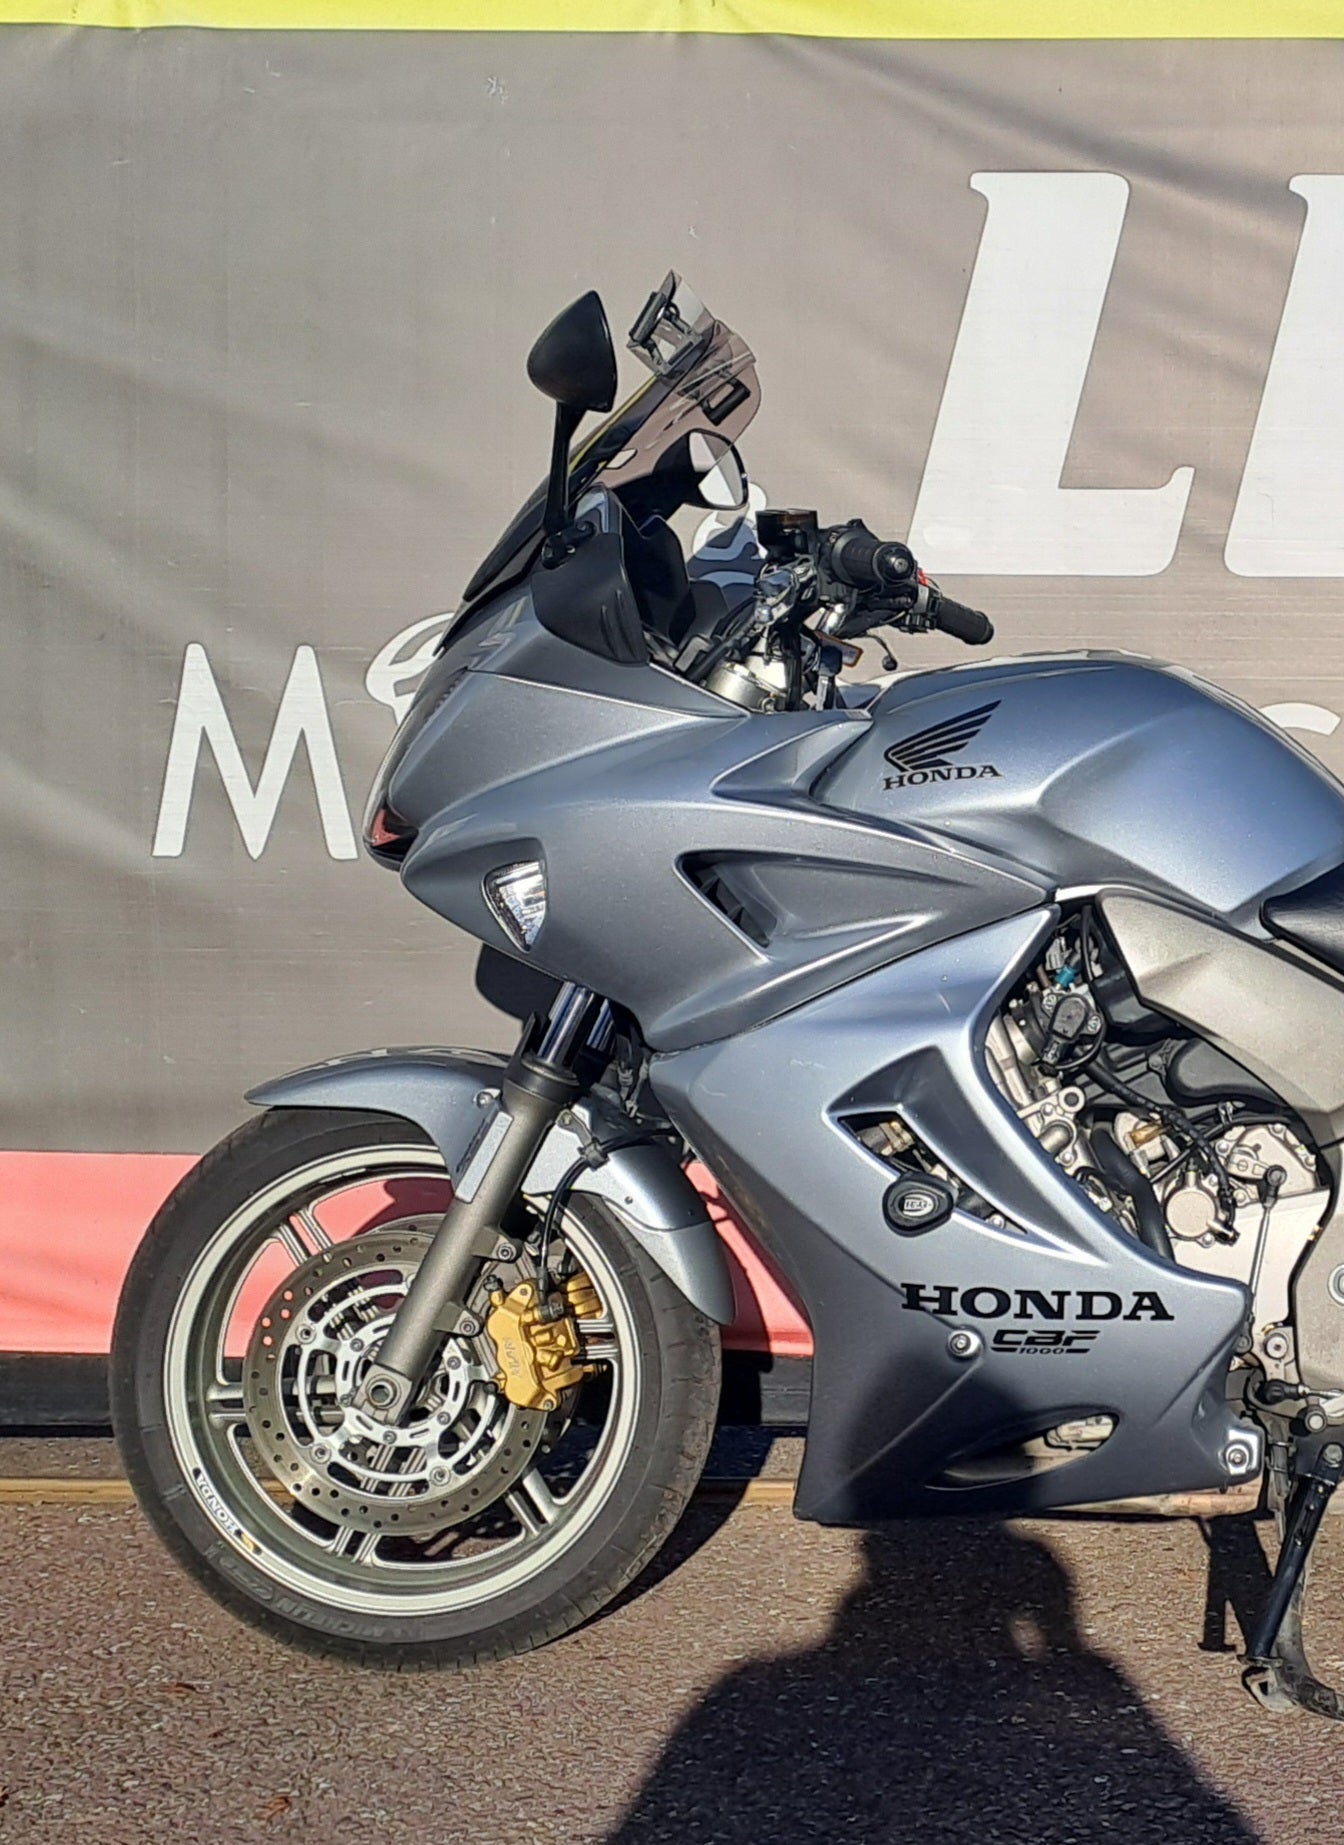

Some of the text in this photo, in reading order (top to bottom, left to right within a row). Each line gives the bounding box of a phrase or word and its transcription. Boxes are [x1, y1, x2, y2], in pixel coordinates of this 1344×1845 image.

[883, 765, 1003, 790] HONDA
[901, 1283, 1175, 1321] HONDA
[992, 1329, 1101, 1346] CBF
[1018, 1346, 1066, 1355] 1000
[196, 1473, 238, 1535] HONDA
